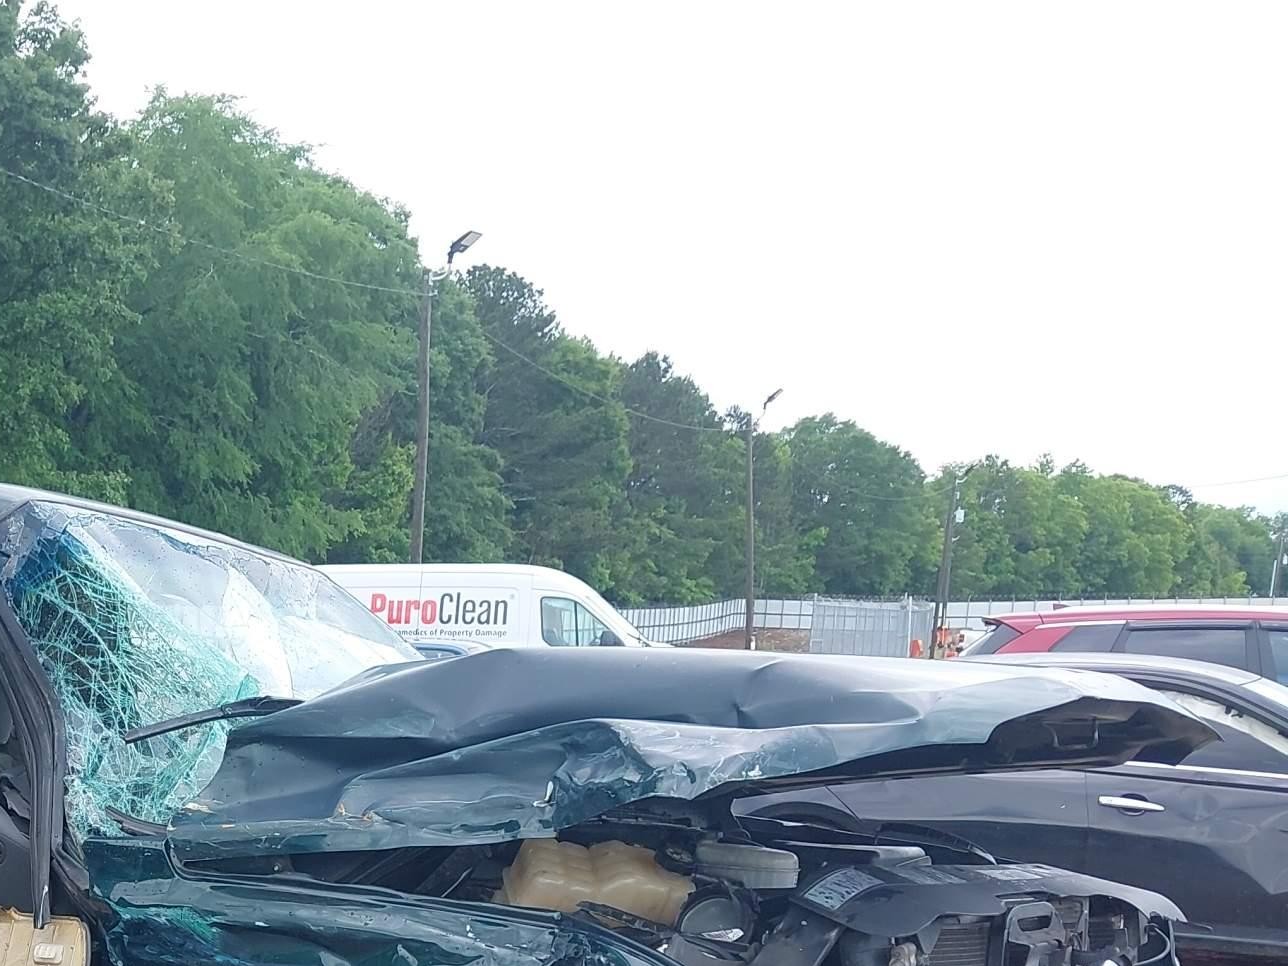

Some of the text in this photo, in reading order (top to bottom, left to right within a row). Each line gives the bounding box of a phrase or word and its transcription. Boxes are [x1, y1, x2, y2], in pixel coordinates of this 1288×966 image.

[371, 592, 508, 625] PuroClean
[429, 628, 437, 636] of
[439, 628, 473, 638] Property
[475, 629, 507, 638] Damage
